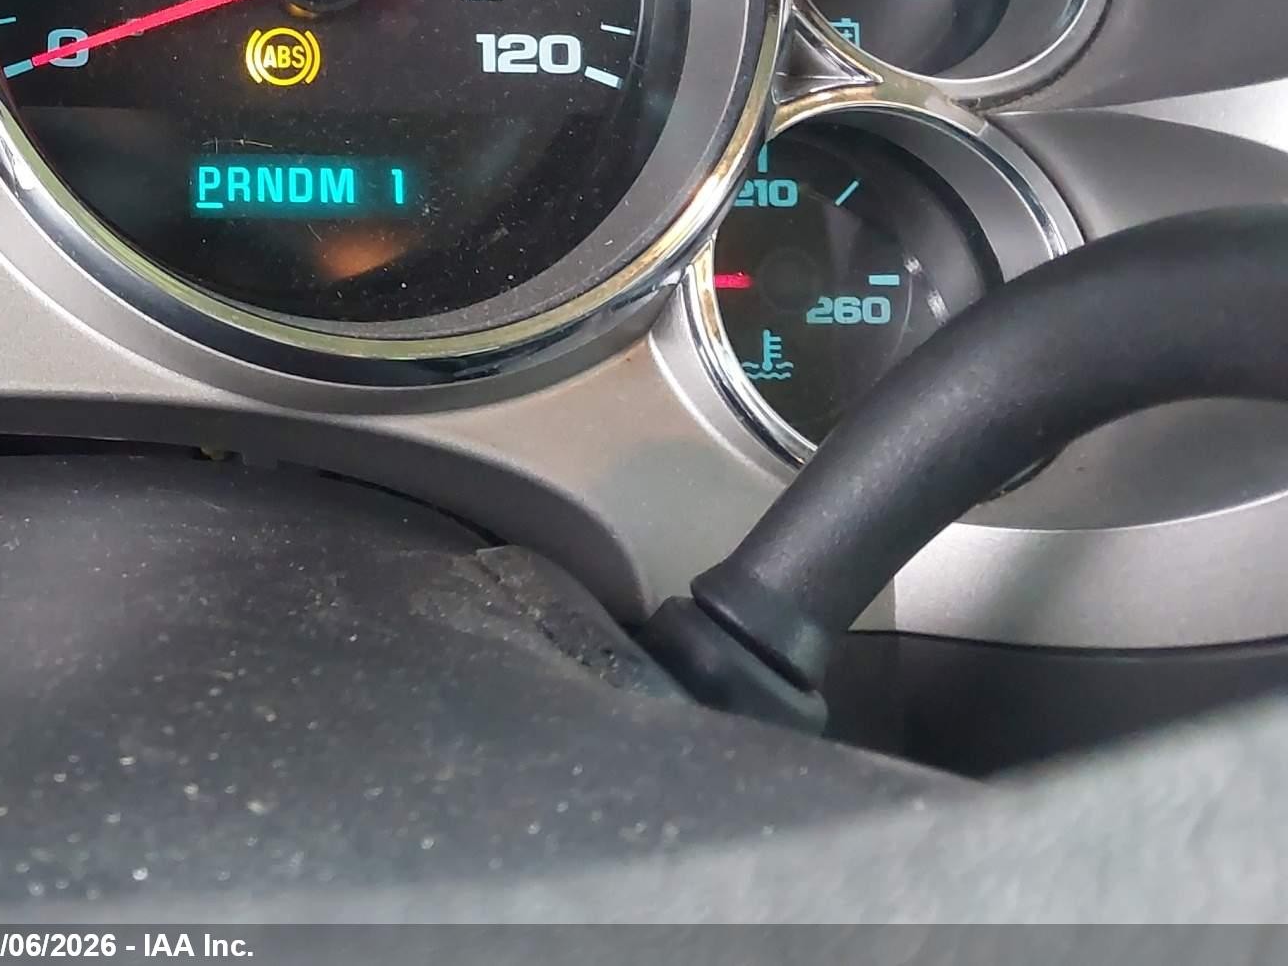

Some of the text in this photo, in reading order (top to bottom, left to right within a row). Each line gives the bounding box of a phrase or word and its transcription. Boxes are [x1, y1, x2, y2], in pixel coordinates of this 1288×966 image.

[47, 28, 89, 68] 0
[263, 42, 305, 70] ABS
[475, 34, 581, 74] 120
[197, 165, 405, 208] PRNDM 1
[806, 296, 891, 324] 260
